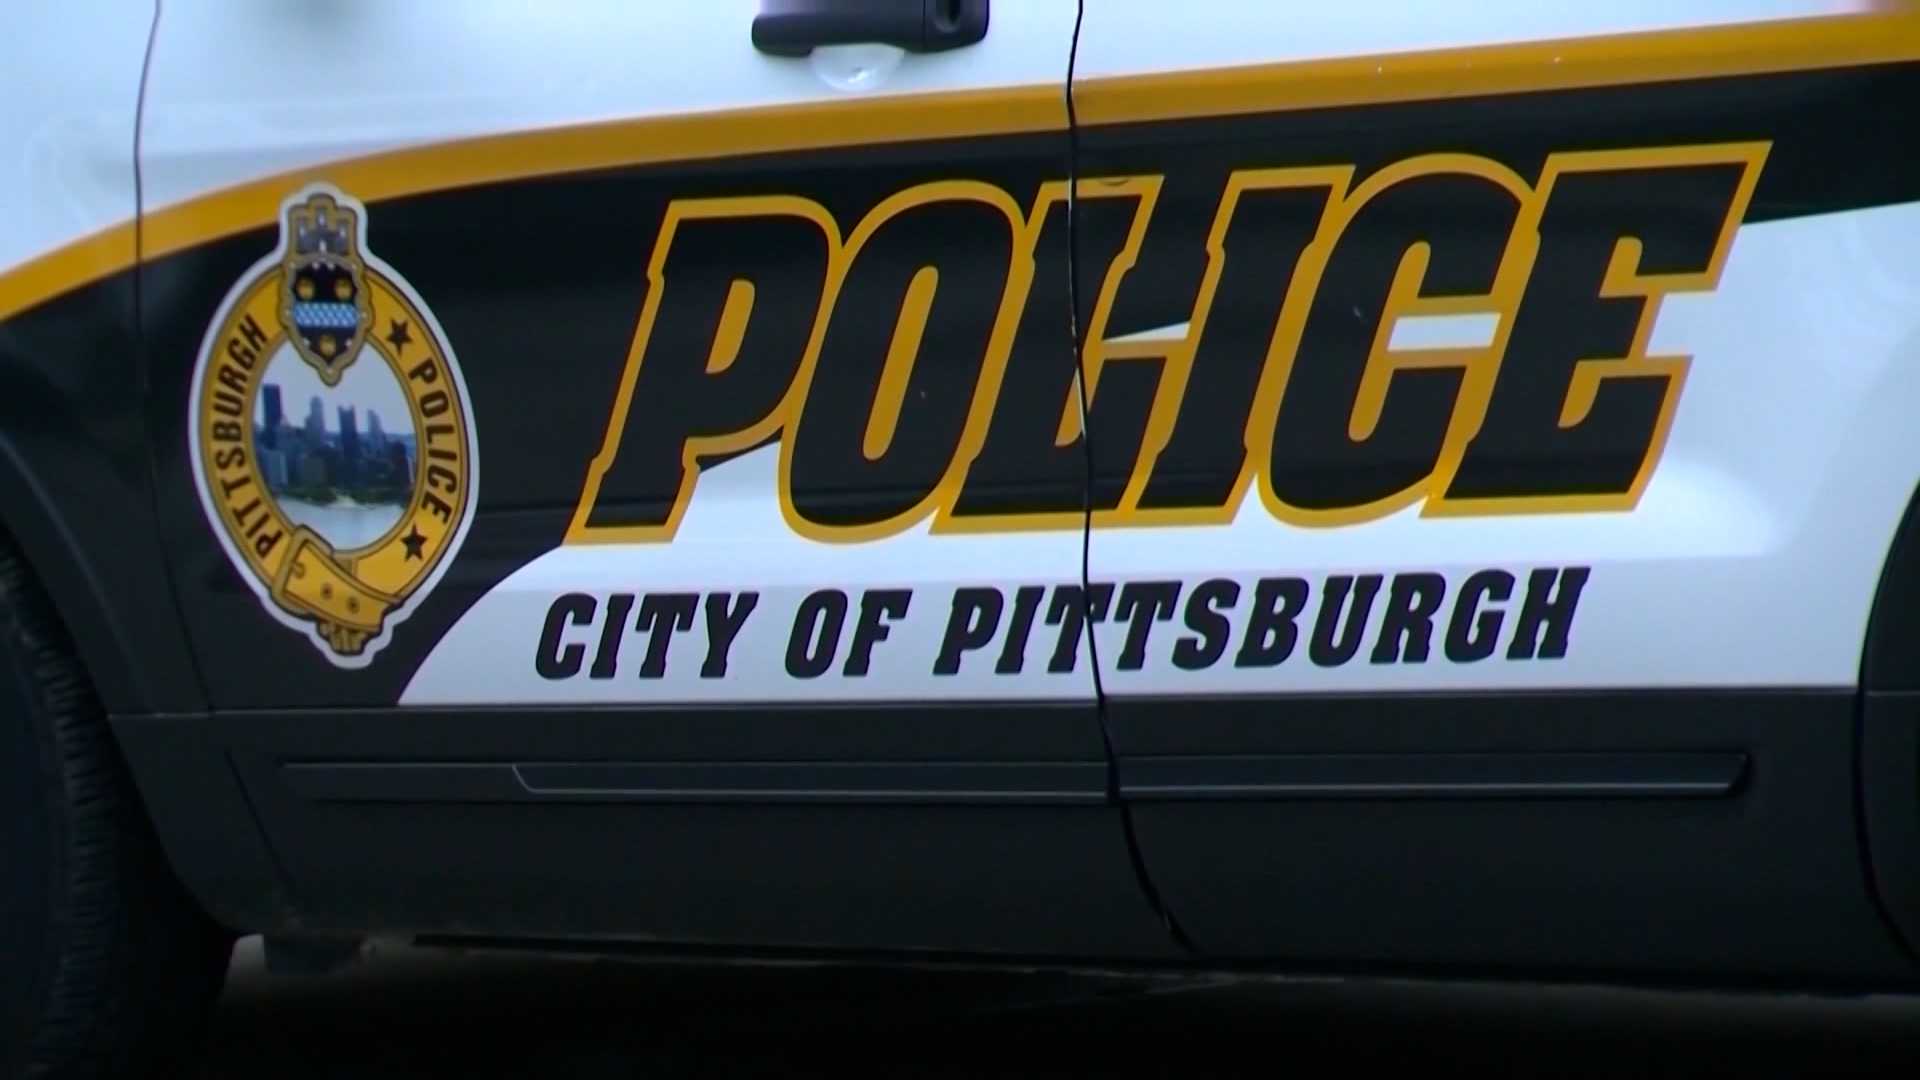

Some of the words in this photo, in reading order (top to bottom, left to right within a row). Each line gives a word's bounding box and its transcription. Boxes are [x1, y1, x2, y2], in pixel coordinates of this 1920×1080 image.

[212, 315, 283, 560] PITTSBURGH
[408, 357, 459, 526] POLICE
[562, 140, 1772, 545] POLICE
[535, 591, 760, 680] CITY
[784, 588, 914, 680] OF
[932, 566, 1592, 676] PITTSBURGH
